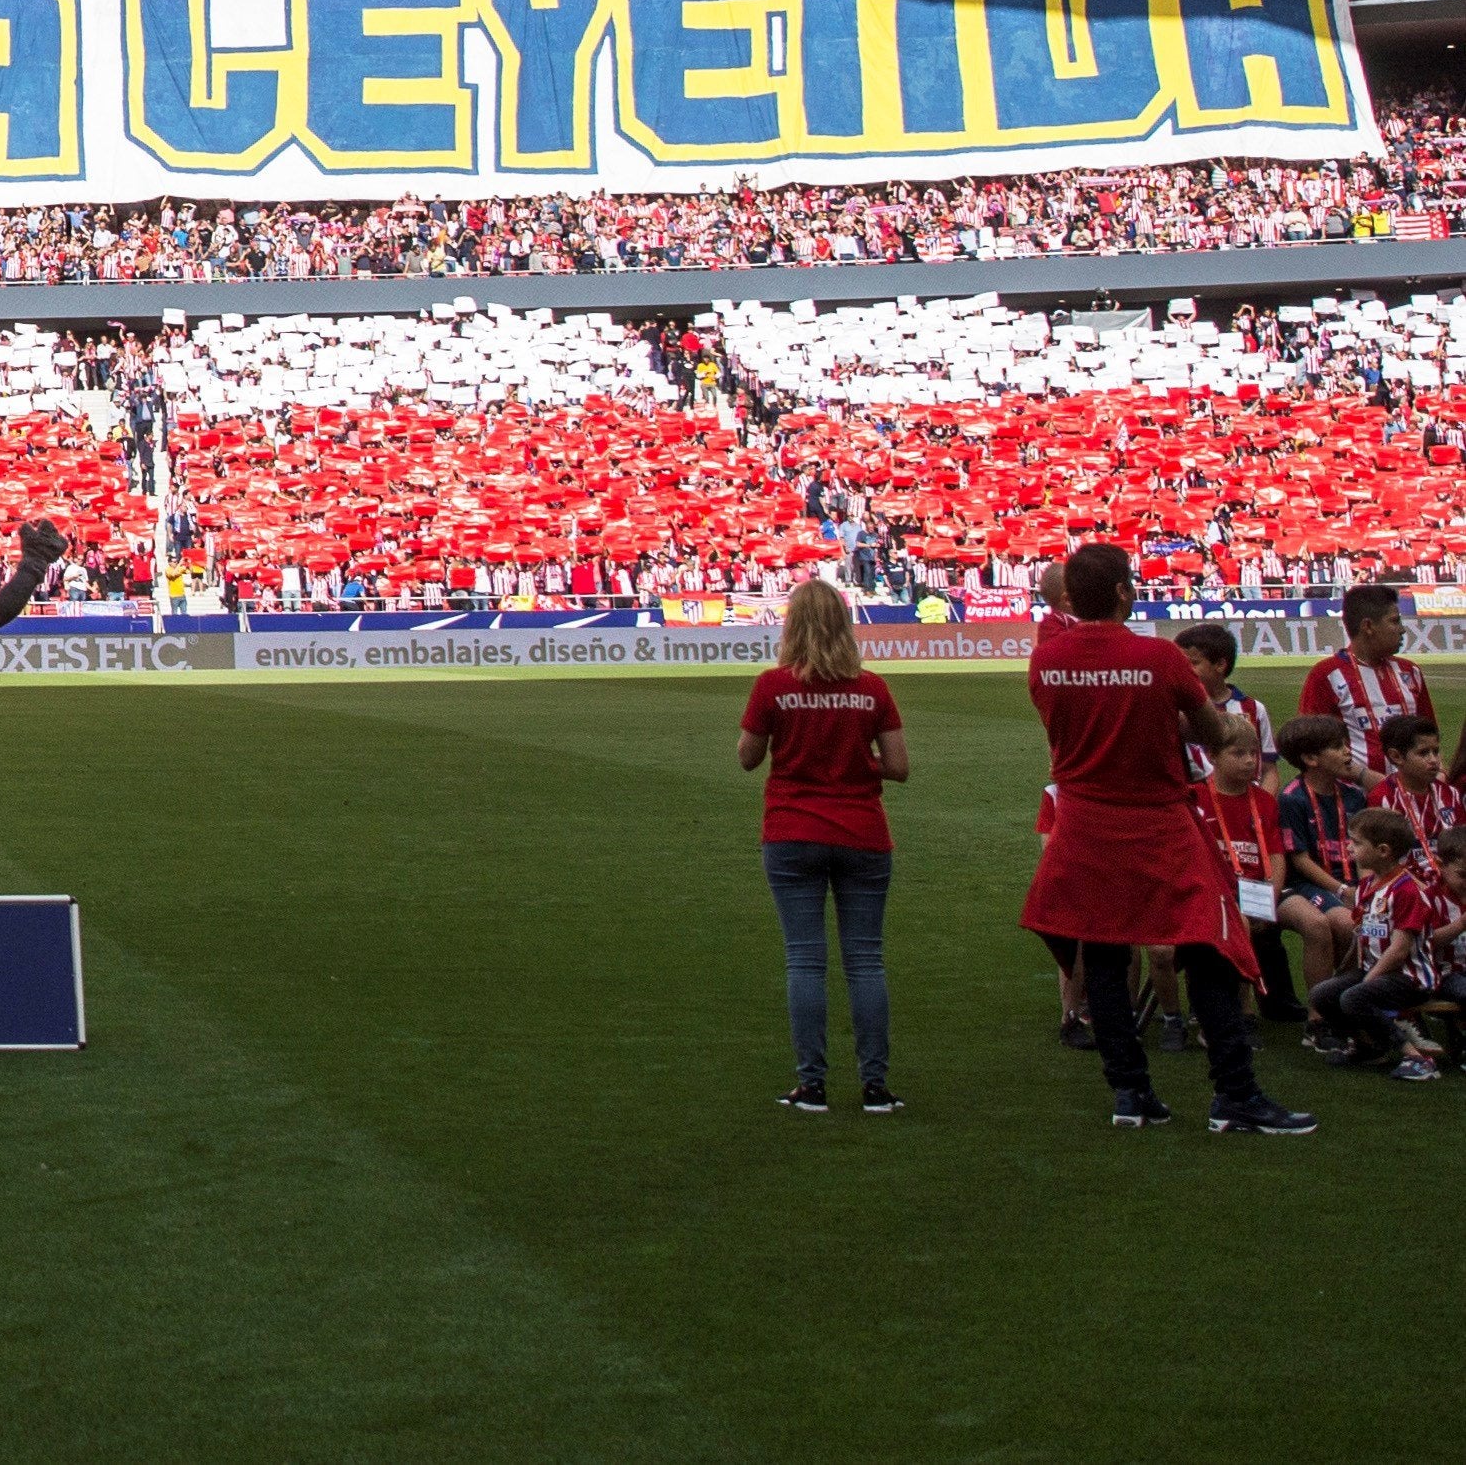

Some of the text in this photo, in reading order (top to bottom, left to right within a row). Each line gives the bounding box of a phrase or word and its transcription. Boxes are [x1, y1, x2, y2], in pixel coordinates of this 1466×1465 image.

[255, 640, 357, 668] envíos,
[365, 638, 520, 667] embalajes,
[528, 636, 626, 664] diseño
[634, 637, 657, 662] &
[1039, 669, 1153, 687] VOLUNTARIO
[775, 692, 875, 711] VOLUNTARIO
